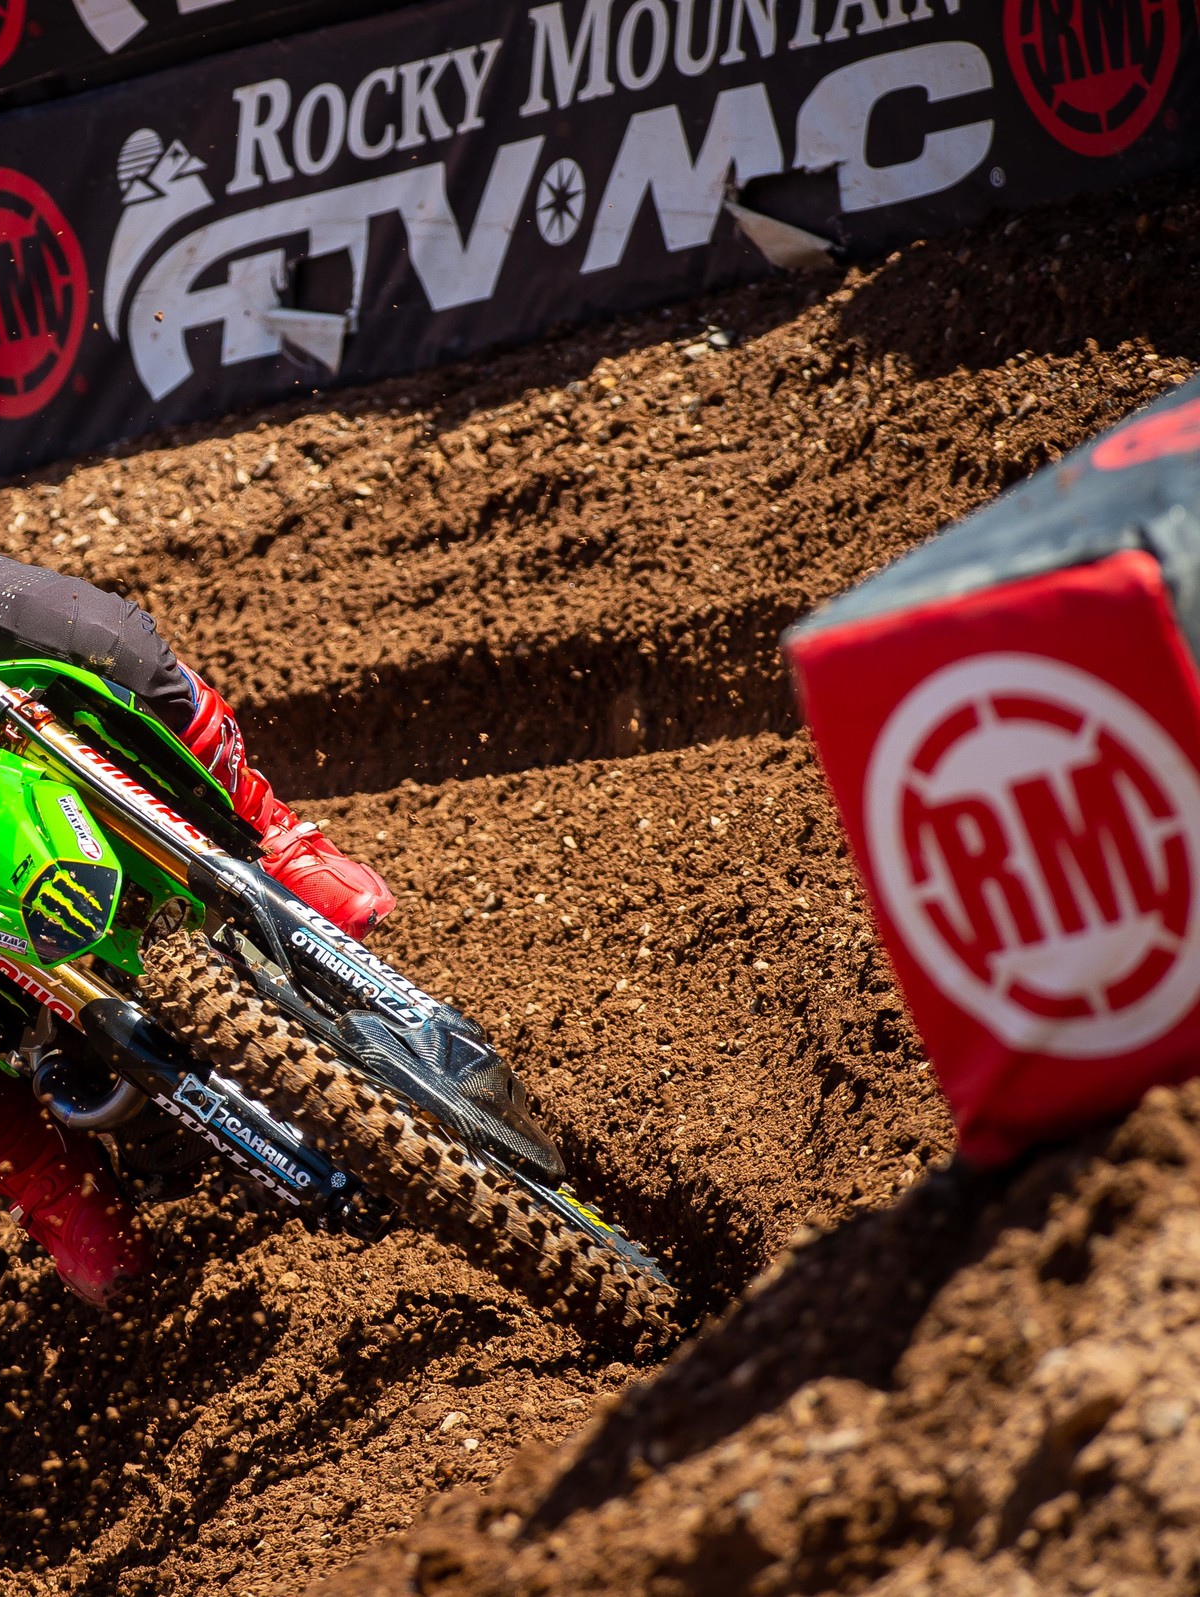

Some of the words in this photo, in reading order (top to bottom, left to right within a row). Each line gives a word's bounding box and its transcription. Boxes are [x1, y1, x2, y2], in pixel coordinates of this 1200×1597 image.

[226, 38, 502, 196] ROCKY
[151, 1093, 302, 1207] DUNLOP
[225, 1113, 312, 1188] CARRILLO
